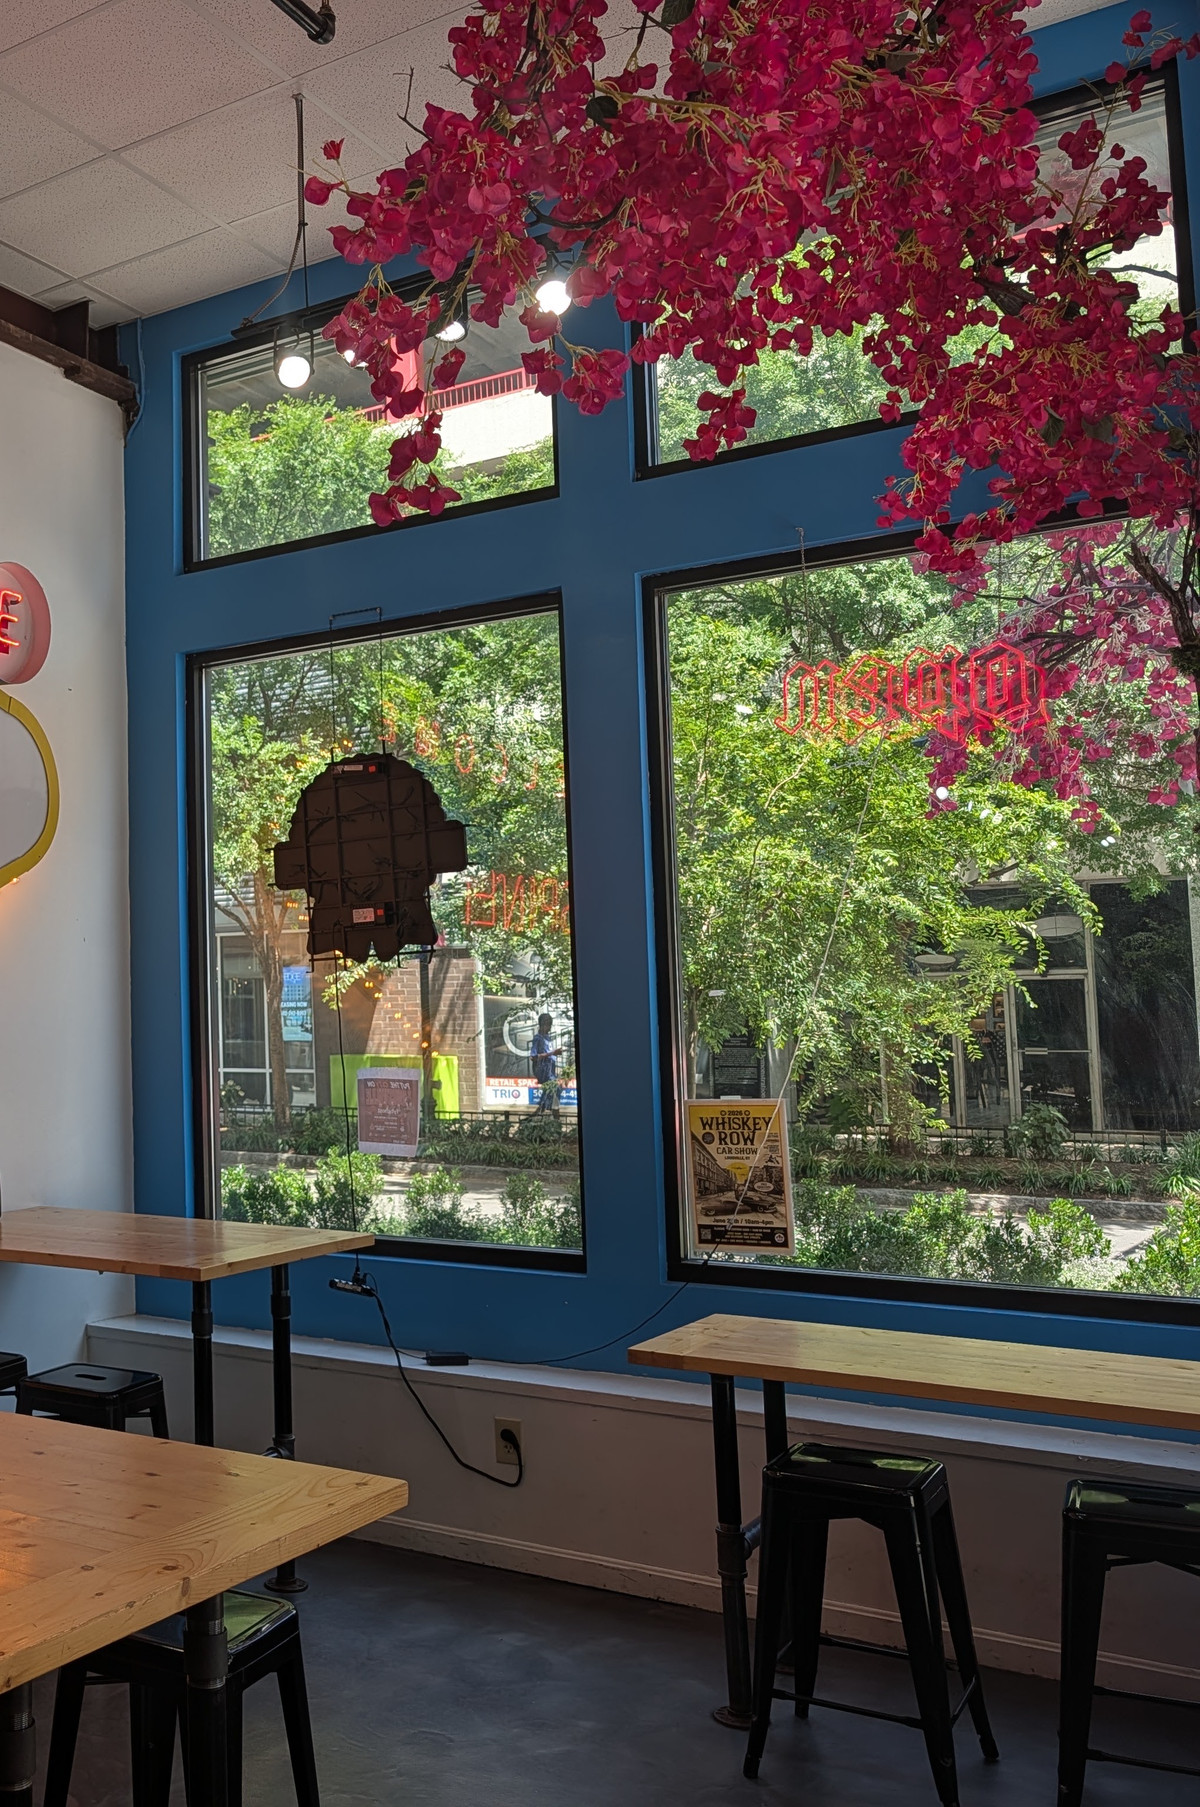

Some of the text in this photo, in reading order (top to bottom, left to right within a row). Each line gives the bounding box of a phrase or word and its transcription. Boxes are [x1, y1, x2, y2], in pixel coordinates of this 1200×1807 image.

[489, 1078, 542, 1087] RETAIL SPAC
[492, 1088, 521, 1099] TRIO
[700, 1117, 773, 1131] WHISKEY
[718, 1131, 756, 1146] ROW
[716, 1146, 733, 1155] CAR
[734, 1147, 759, 1156] SHOW
